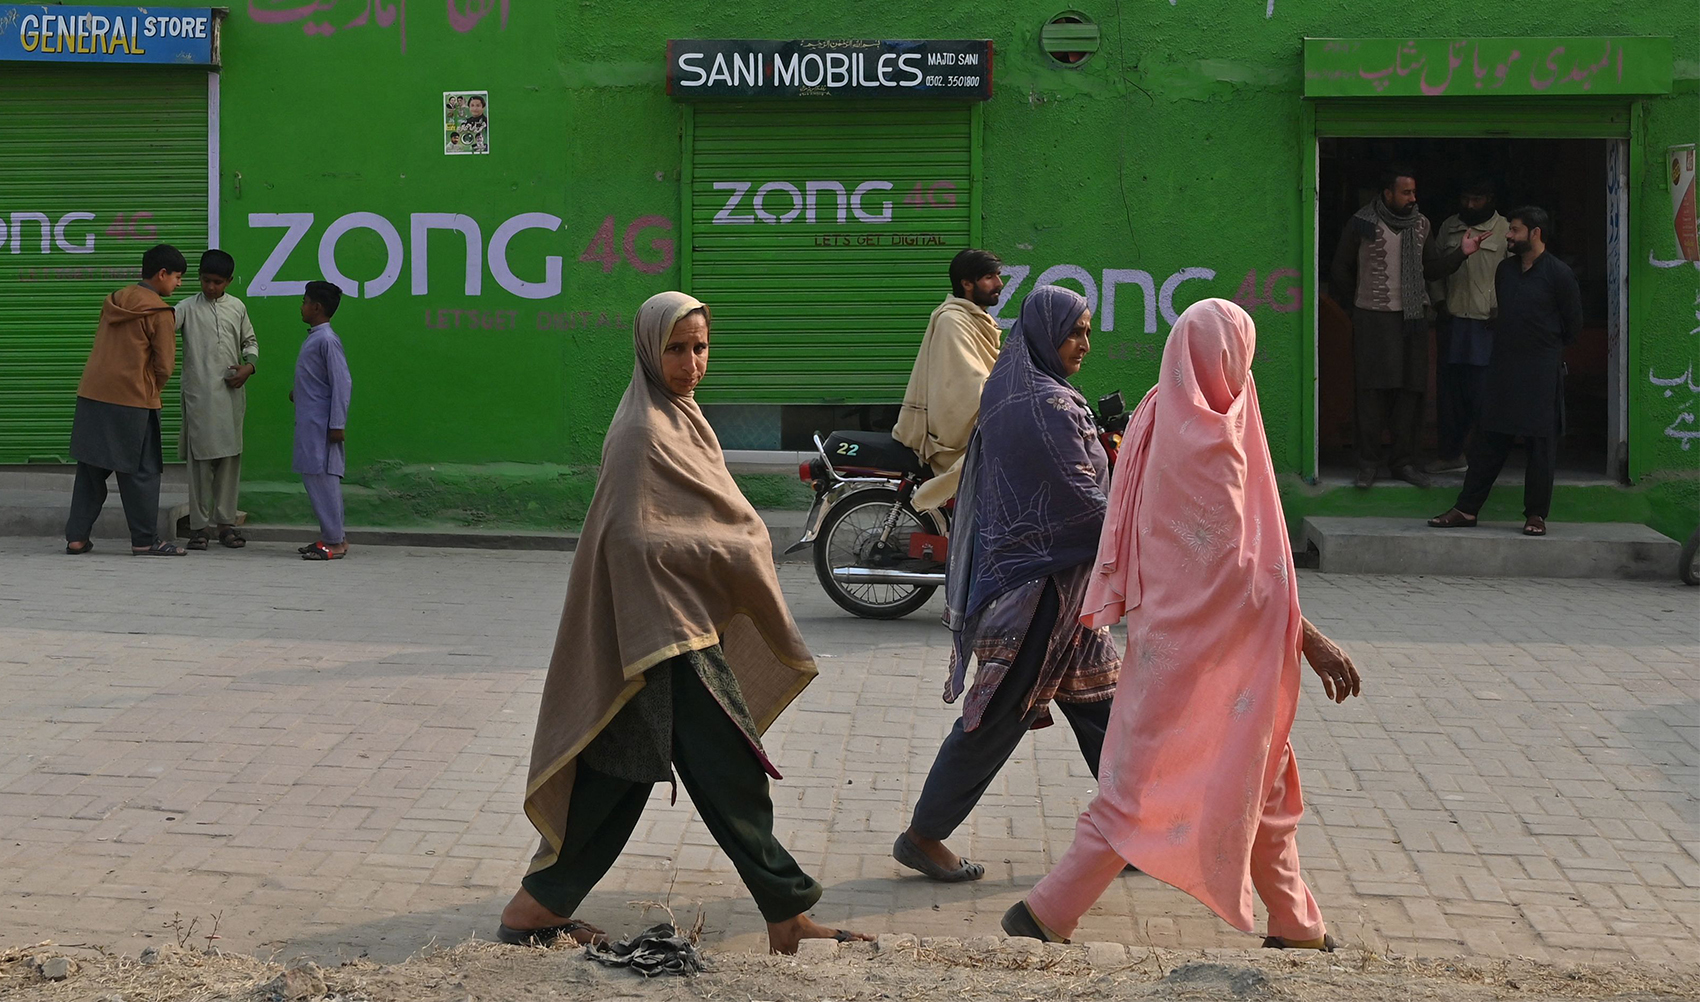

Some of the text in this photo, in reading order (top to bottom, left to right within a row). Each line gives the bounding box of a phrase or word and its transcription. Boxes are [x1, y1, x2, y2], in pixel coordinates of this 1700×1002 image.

[20, 14, 146, 54] GENERAL
[144, 16, 208, 39] STORE
[678, 52, 923, 87] SANI MOBILES
[927, 52, 979, 66] MAJID SANI
[947, 75, 980, 88] 3501800
[903, 180, 957, 210] 4G
[105, 211, 158, 241] 4G
[856, 233, 882, 246] GET
[891, 233, 946, 246] DIGITAL
[578, 214, 674, 274] 4G
[1231, 268, 1303, 313] 4G
[536, 311, 630, 331] DIGITAL
[837, 442, 860, 456] 22
